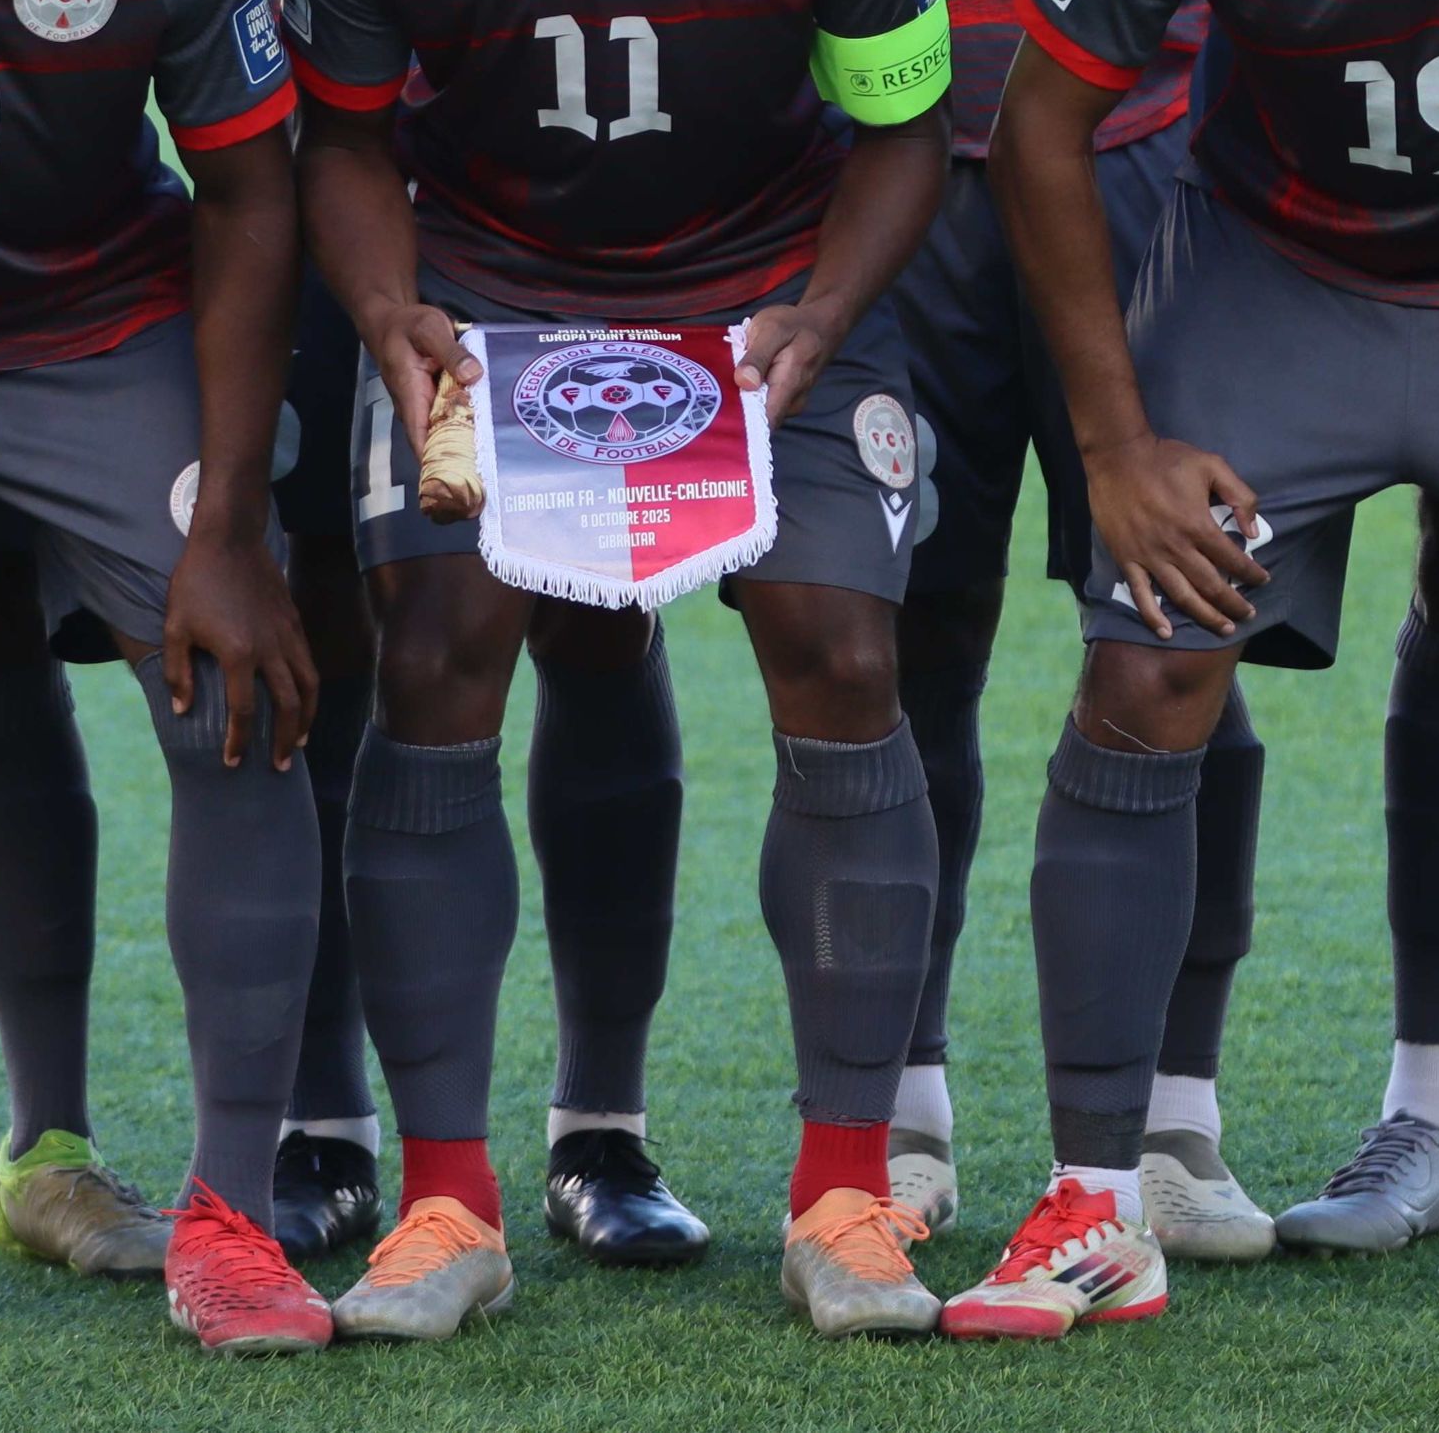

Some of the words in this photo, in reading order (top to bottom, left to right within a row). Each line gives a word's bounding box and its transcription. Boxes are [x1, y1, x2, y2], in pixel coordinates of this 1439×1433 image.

[882, 32, 951, 90] RESPEC
[533, 14, 672, 141] 11
[539, 334, 587, 343] EUROPA
[590, 333, 625, 341] POINT
[628, 333, 682, 341] STADIUM
[520, 347, 591, 400] FÉDÉRATION
[603, 344, 712, 393] CALÉDONIENNE
[555, 436, 581, 453] DE
[593, 429, 689, 459] FOOTBALL
[505, 490, 575, 512] GIBRALTAR
[579, 489, 595, 506] FA
[608, 479, 749, 504] NOUVELLE-CALÉDONIE
[581, 515, 588, 528] 8
[591, 511, 639, 527] OCTOBRE
[642, 508, 671, 525] 2025
[598, 531, 656, 549] GIBRALTAR
